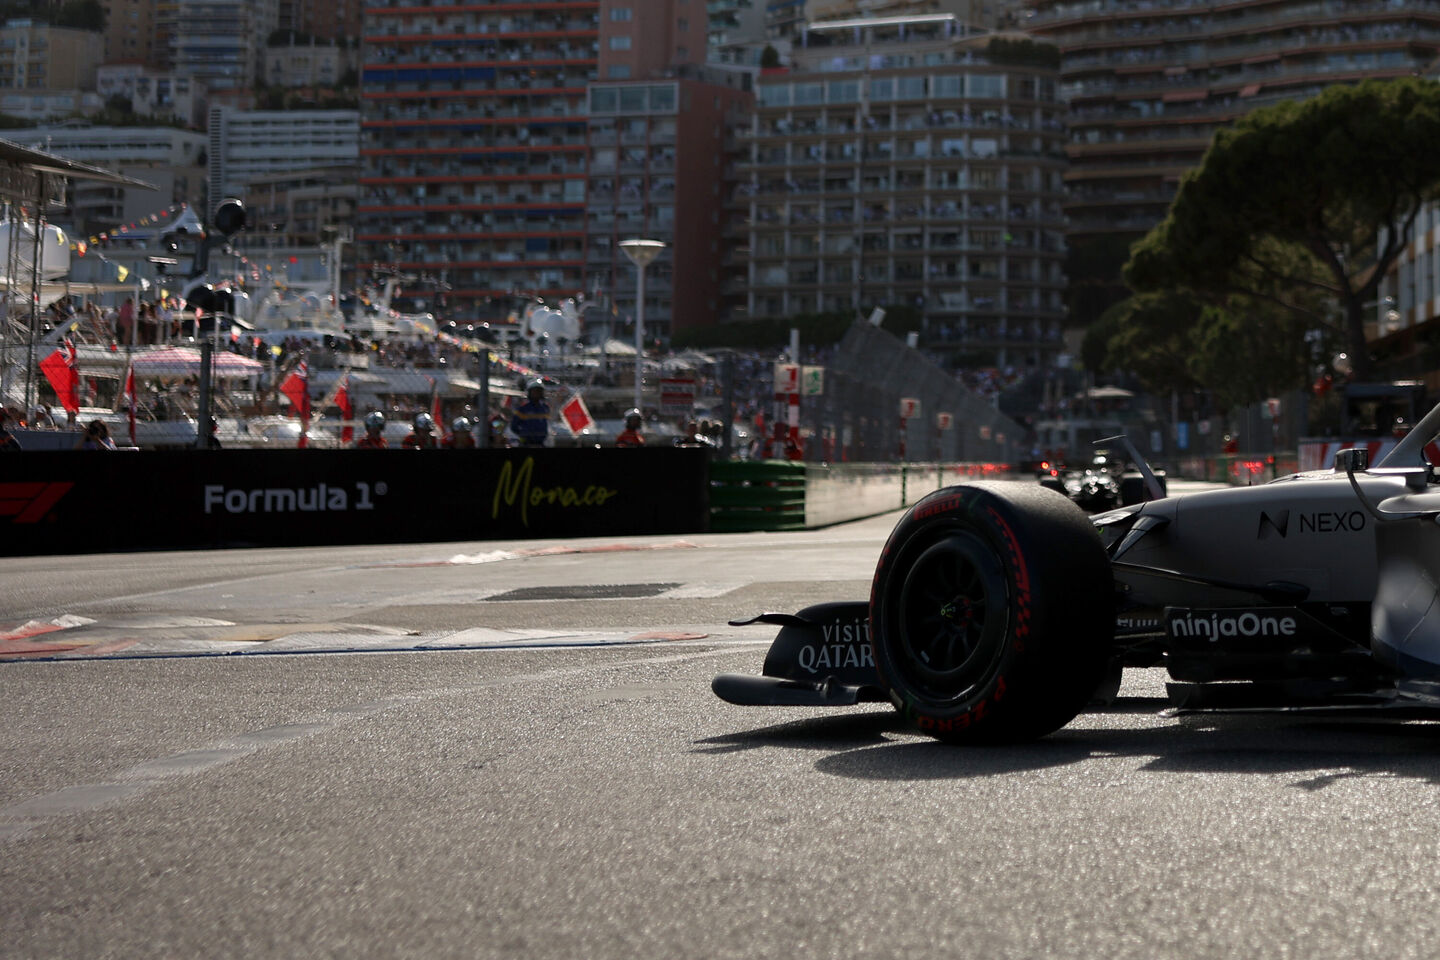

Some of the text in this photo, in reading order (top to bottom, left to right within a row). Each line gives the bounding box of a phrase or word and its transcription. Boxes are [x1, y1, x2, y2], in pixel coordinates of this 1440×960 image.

[204, 483, 348, 514] Formula
[492, 456, 618, 528] Monaco
[1300, 511, 1365, 532] NEXO
[822, 617, 872, 643] visit
[1172, 613, 1297, 642] ninjaOne
[798, 644, 876, 673] QATAR
